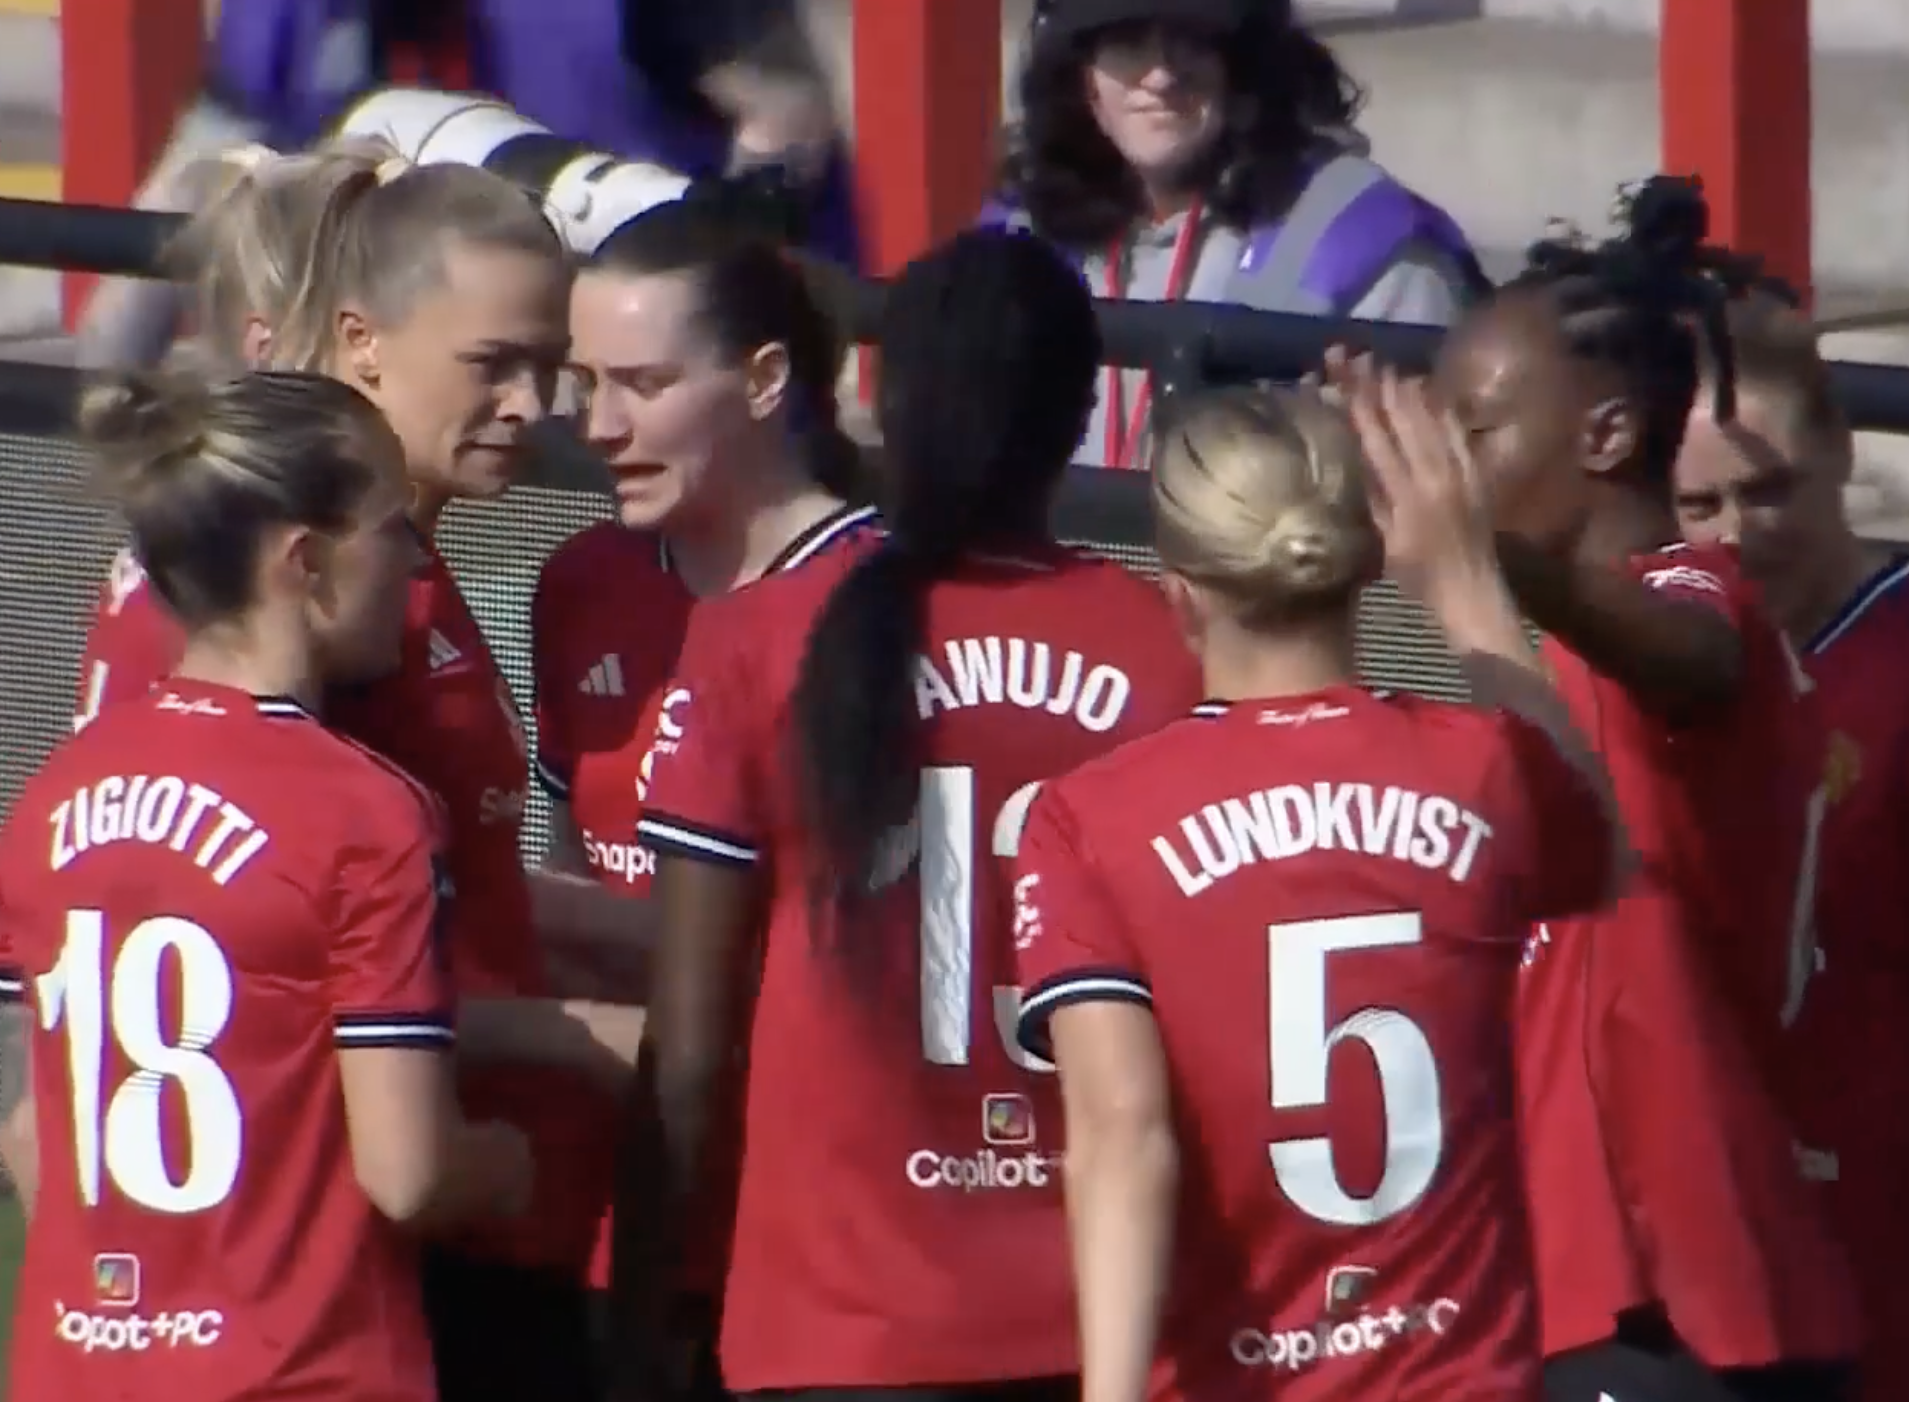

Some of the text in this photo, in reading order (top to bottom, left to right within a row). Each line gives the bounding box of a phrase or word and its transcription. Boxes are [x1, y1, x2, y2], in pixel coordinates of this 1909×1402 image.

[912, 635, 1131, 732] AWUJO
[49, 776, 269, 886] ZIGIOTTI
[1151, 782, 1494, 898] LUNDKVIST
[37, 909, 241, 1213] 18
[1269, 911, 1442, 1226] 5
